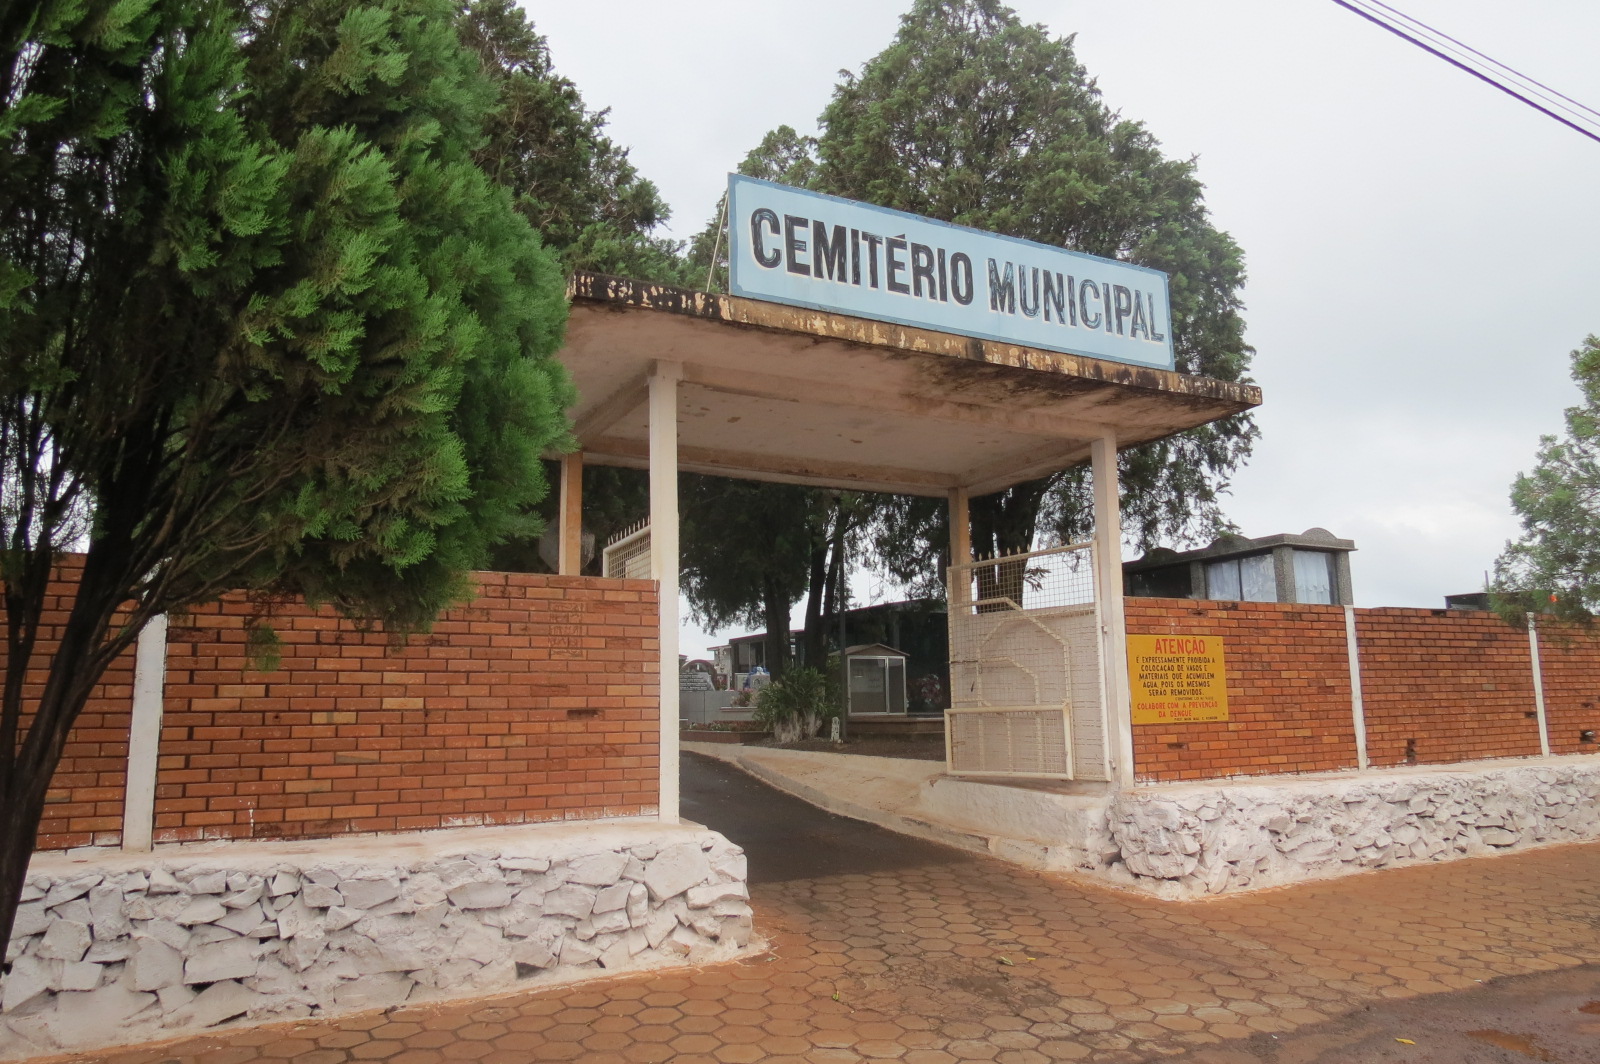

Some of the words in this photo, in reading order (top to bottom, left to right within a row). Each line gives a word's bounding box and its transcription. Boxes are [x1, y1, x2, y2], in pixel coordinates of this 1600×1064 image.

[750, 207, 973, 306] CEMITÉRIO
[987, 257, 1165, 343] MUNICIPAL
[1155, 636, 1206, 656] ATENÇÃO
[1142, 656, 1186, 664] EXPRESSAMENTE
[1187, 656, 1211, 664] PROIBIDA
[1177, 664, 1185, 672] DE
[1186, 664, 1203, 672] VASOS
[1204, 664, 1208, 672] E
[1138, 672, 1169, 680] MATERIAIS
[1172, 672, 1183, 680] QUE
[1186, 672, 1215, 680] ACUMULEM
[1161, 680, 1174, 688] POIS
[1176, 680, 1184, 688] OS
[1187, 680, 1211, 688] MESMOS
[1137, 702, 1166, 710] COLABORE
[1170, 709, 1192, 718] DENGUE
